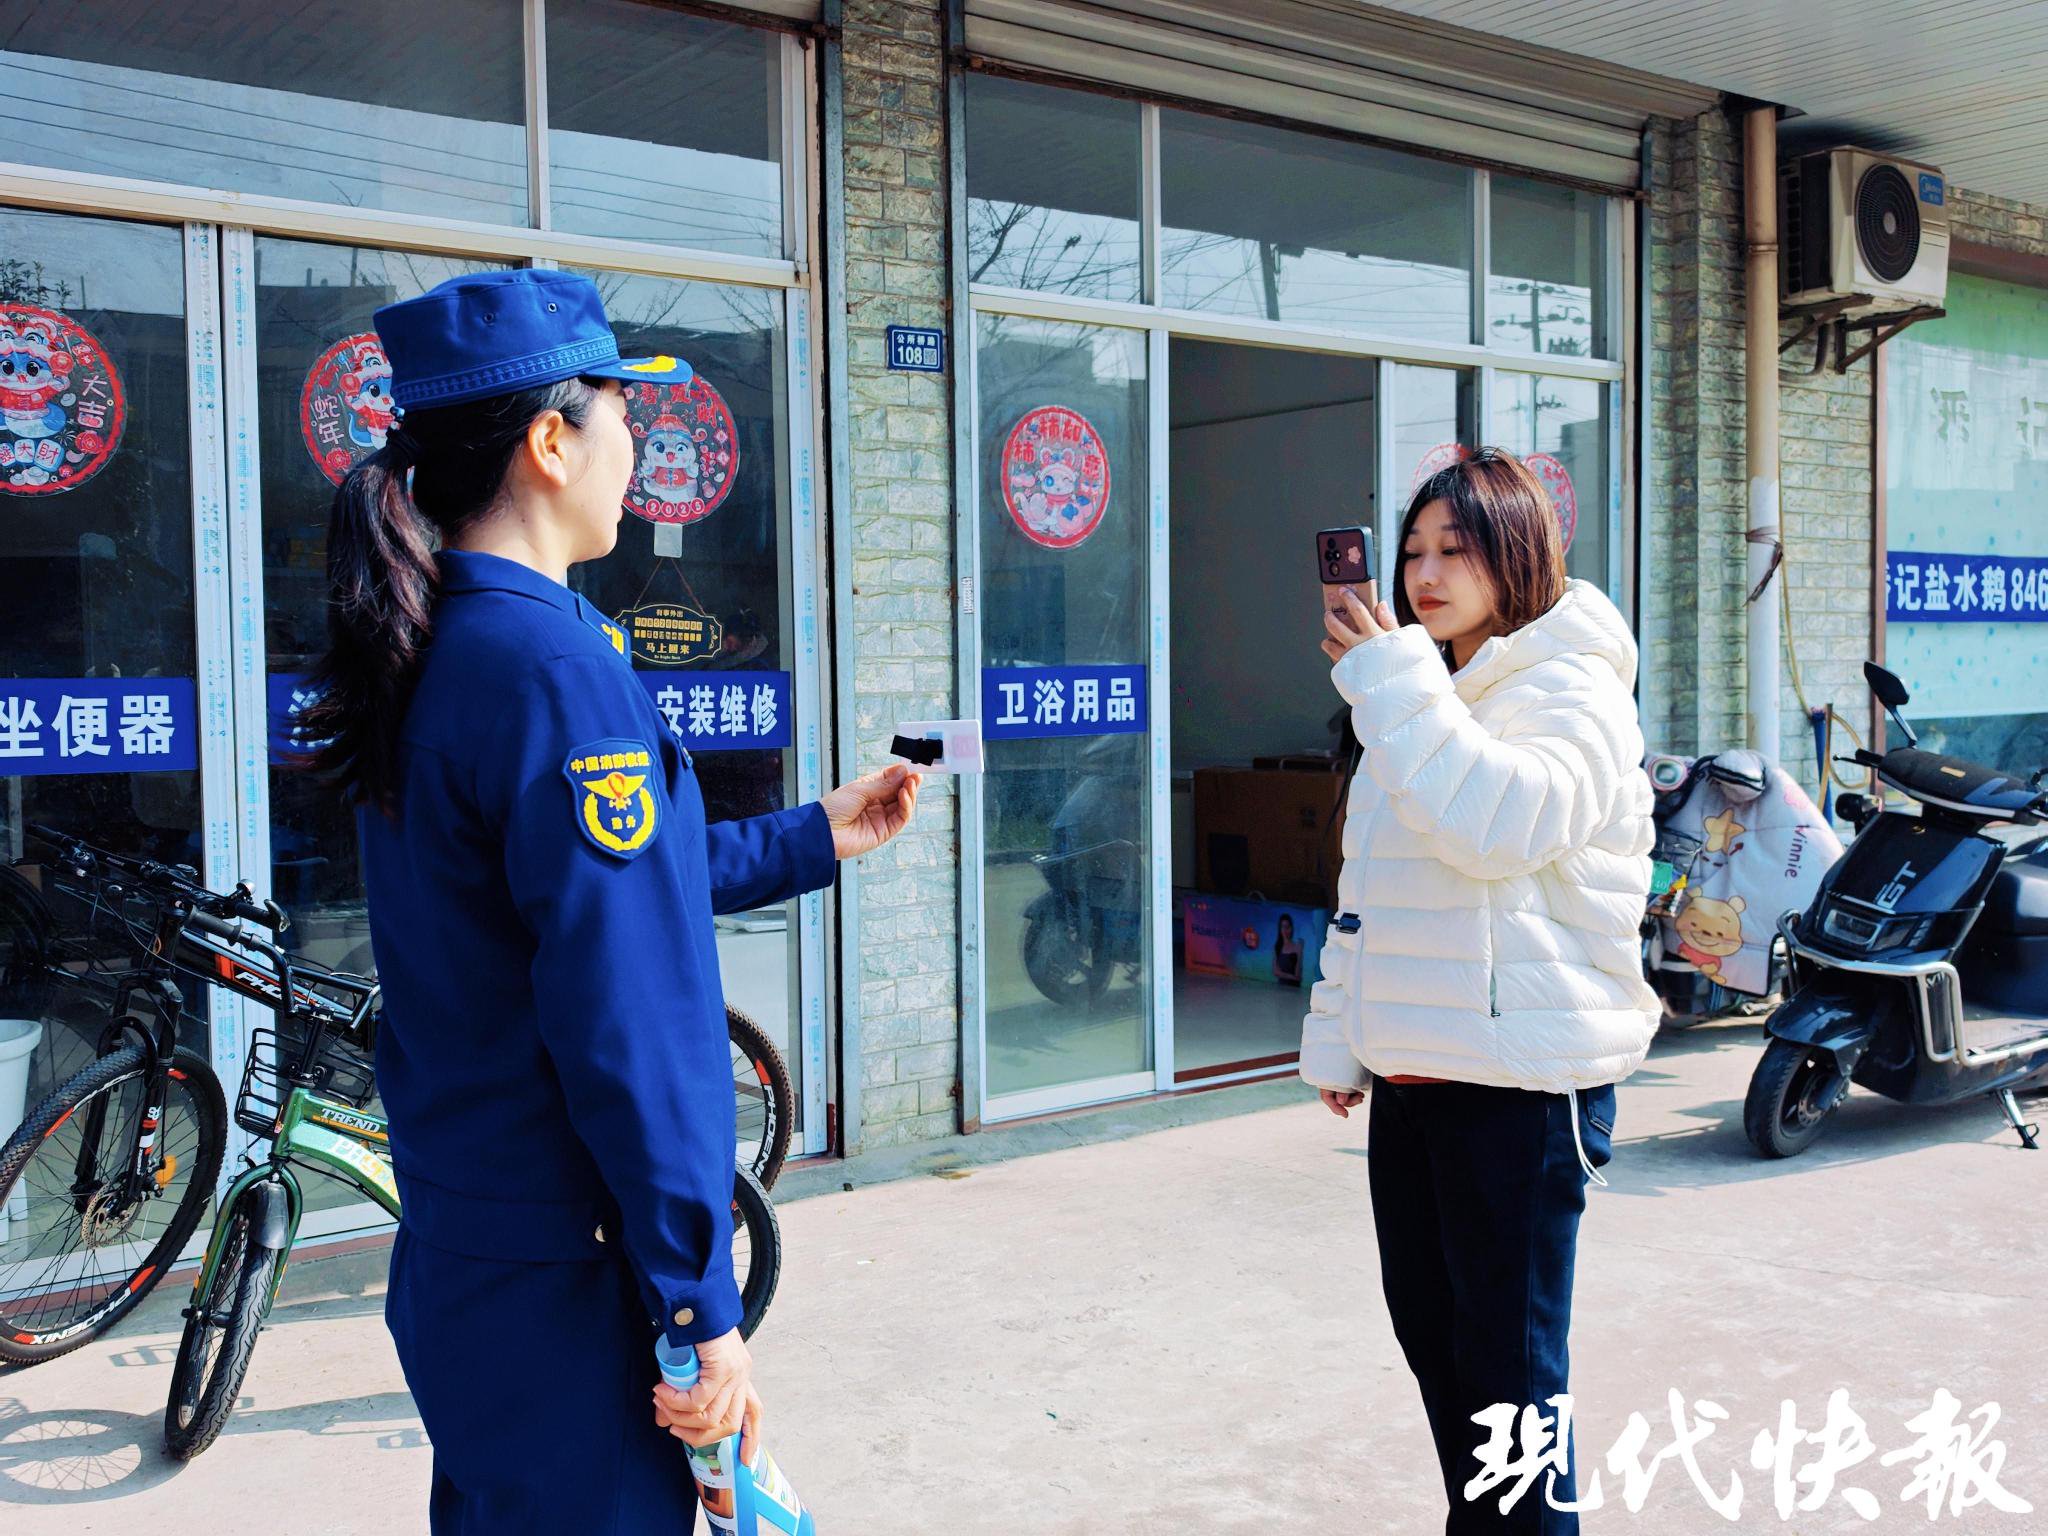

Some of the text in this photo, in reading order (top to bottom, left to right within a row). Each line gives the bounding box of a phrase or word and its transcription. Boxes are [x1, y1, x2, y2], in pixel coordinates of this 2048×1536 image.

[897, 345, 923, 365] 108
[78, 374, 108, 428] 大吉
[314, 394, 345, 445] 蛇年
[648, 499, 703, 516] 2025
[645, 642, 690, 655] 马上回来
[0, 694, 175, 758] 坐便器
[656, 683, 778, 738] 安装维修
[996, 677, 1136, 726] 卫浴用品
[321, 1108, 381, 1133] TREND
[30, 1286, 132, 1345] PHOENIX
